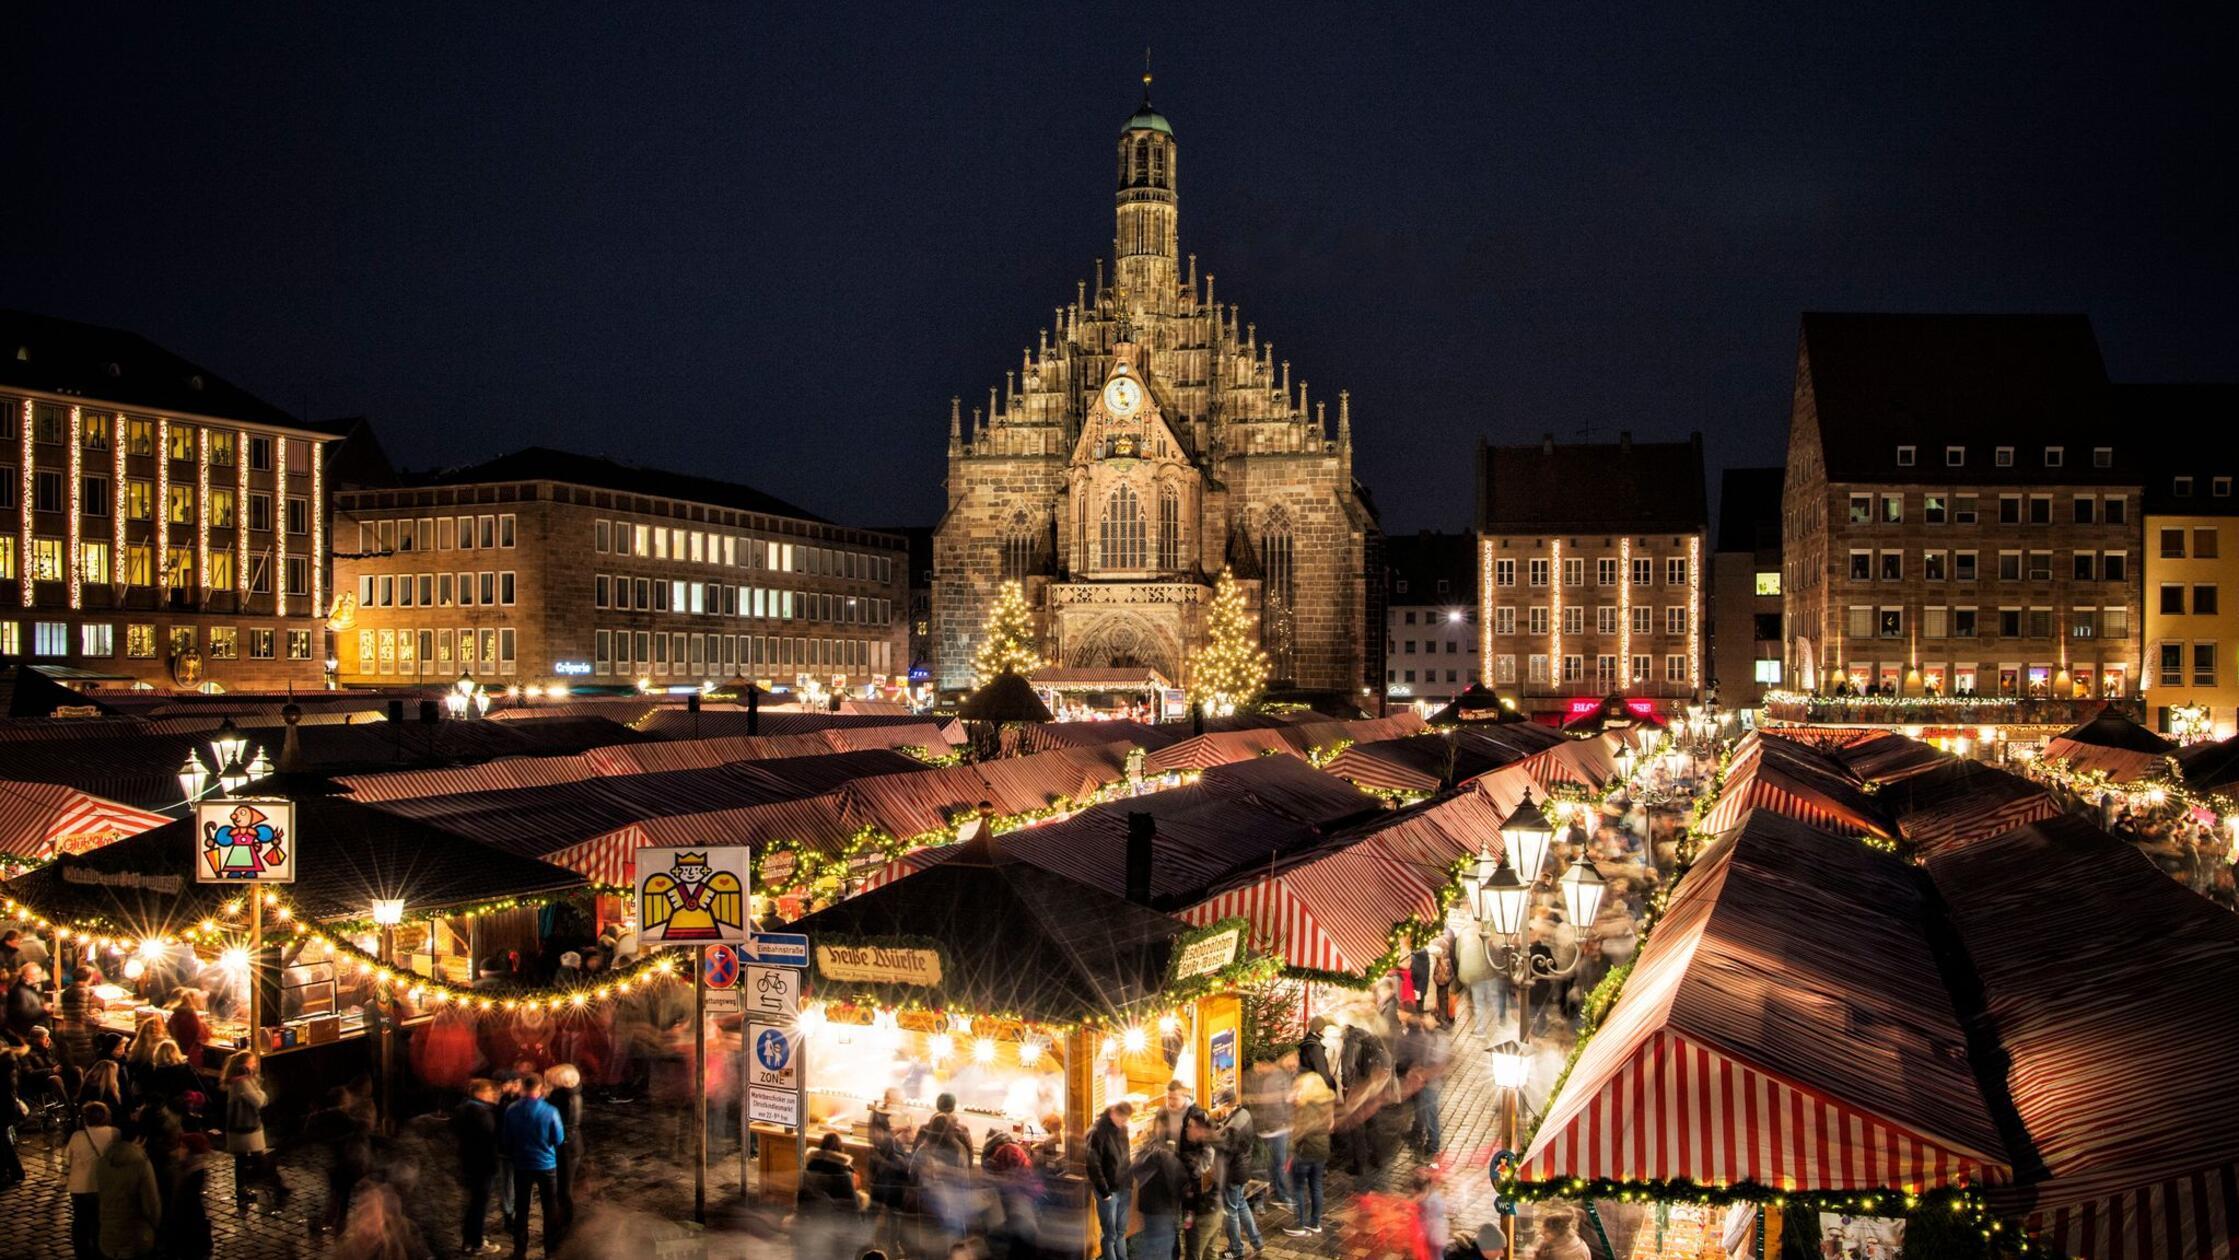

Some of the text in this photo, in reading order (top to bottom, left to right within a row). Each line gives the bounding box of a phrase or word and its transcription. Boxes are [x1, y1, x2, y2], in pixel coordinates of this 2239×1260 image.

[757, 942, 804, 955] Einbahnstraße
[704, 996, 737, 1007] ettungsweg
[760, 1071, 785, 1085] ZONE
[1498, 1201, 1510, 1211] WC
